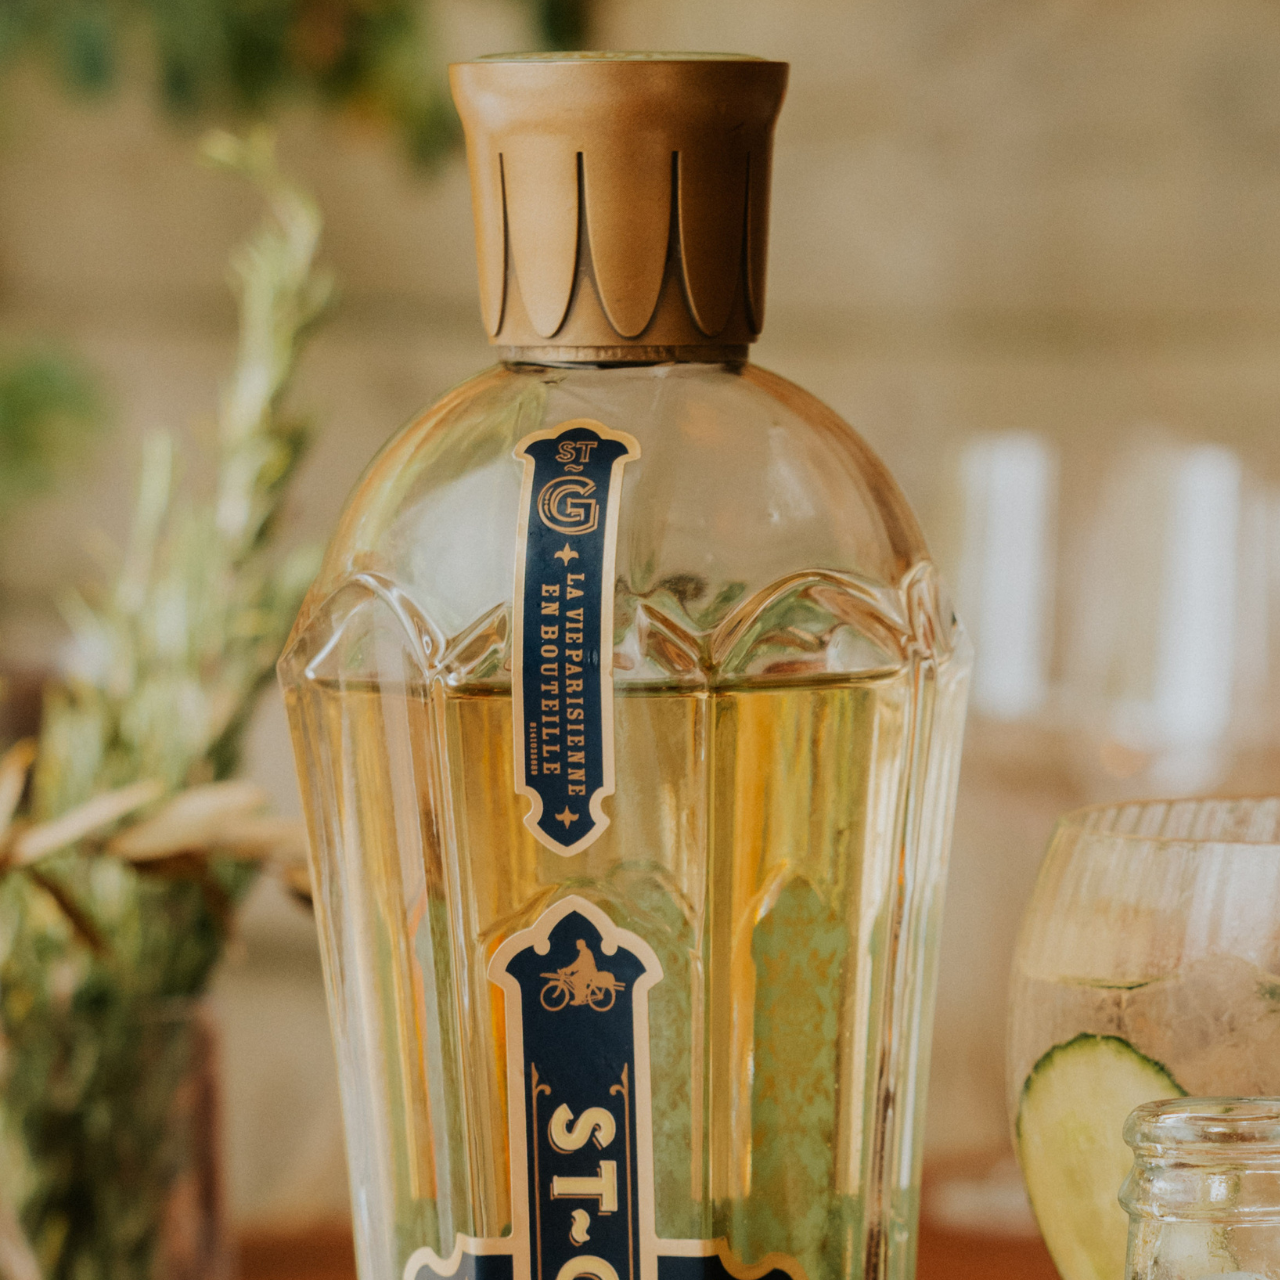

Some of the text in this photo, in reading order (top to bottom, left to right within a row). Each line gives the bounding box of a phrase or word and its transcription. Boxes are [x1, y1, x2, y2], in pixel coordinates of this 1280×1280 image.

[537, 475, 600, 535] G
[555, 441, 598, 463] ST
[540, 583, 561, 776] EN BOUTEILLE
[565, 573, 587, 797] LA VIE PARISIENNE
